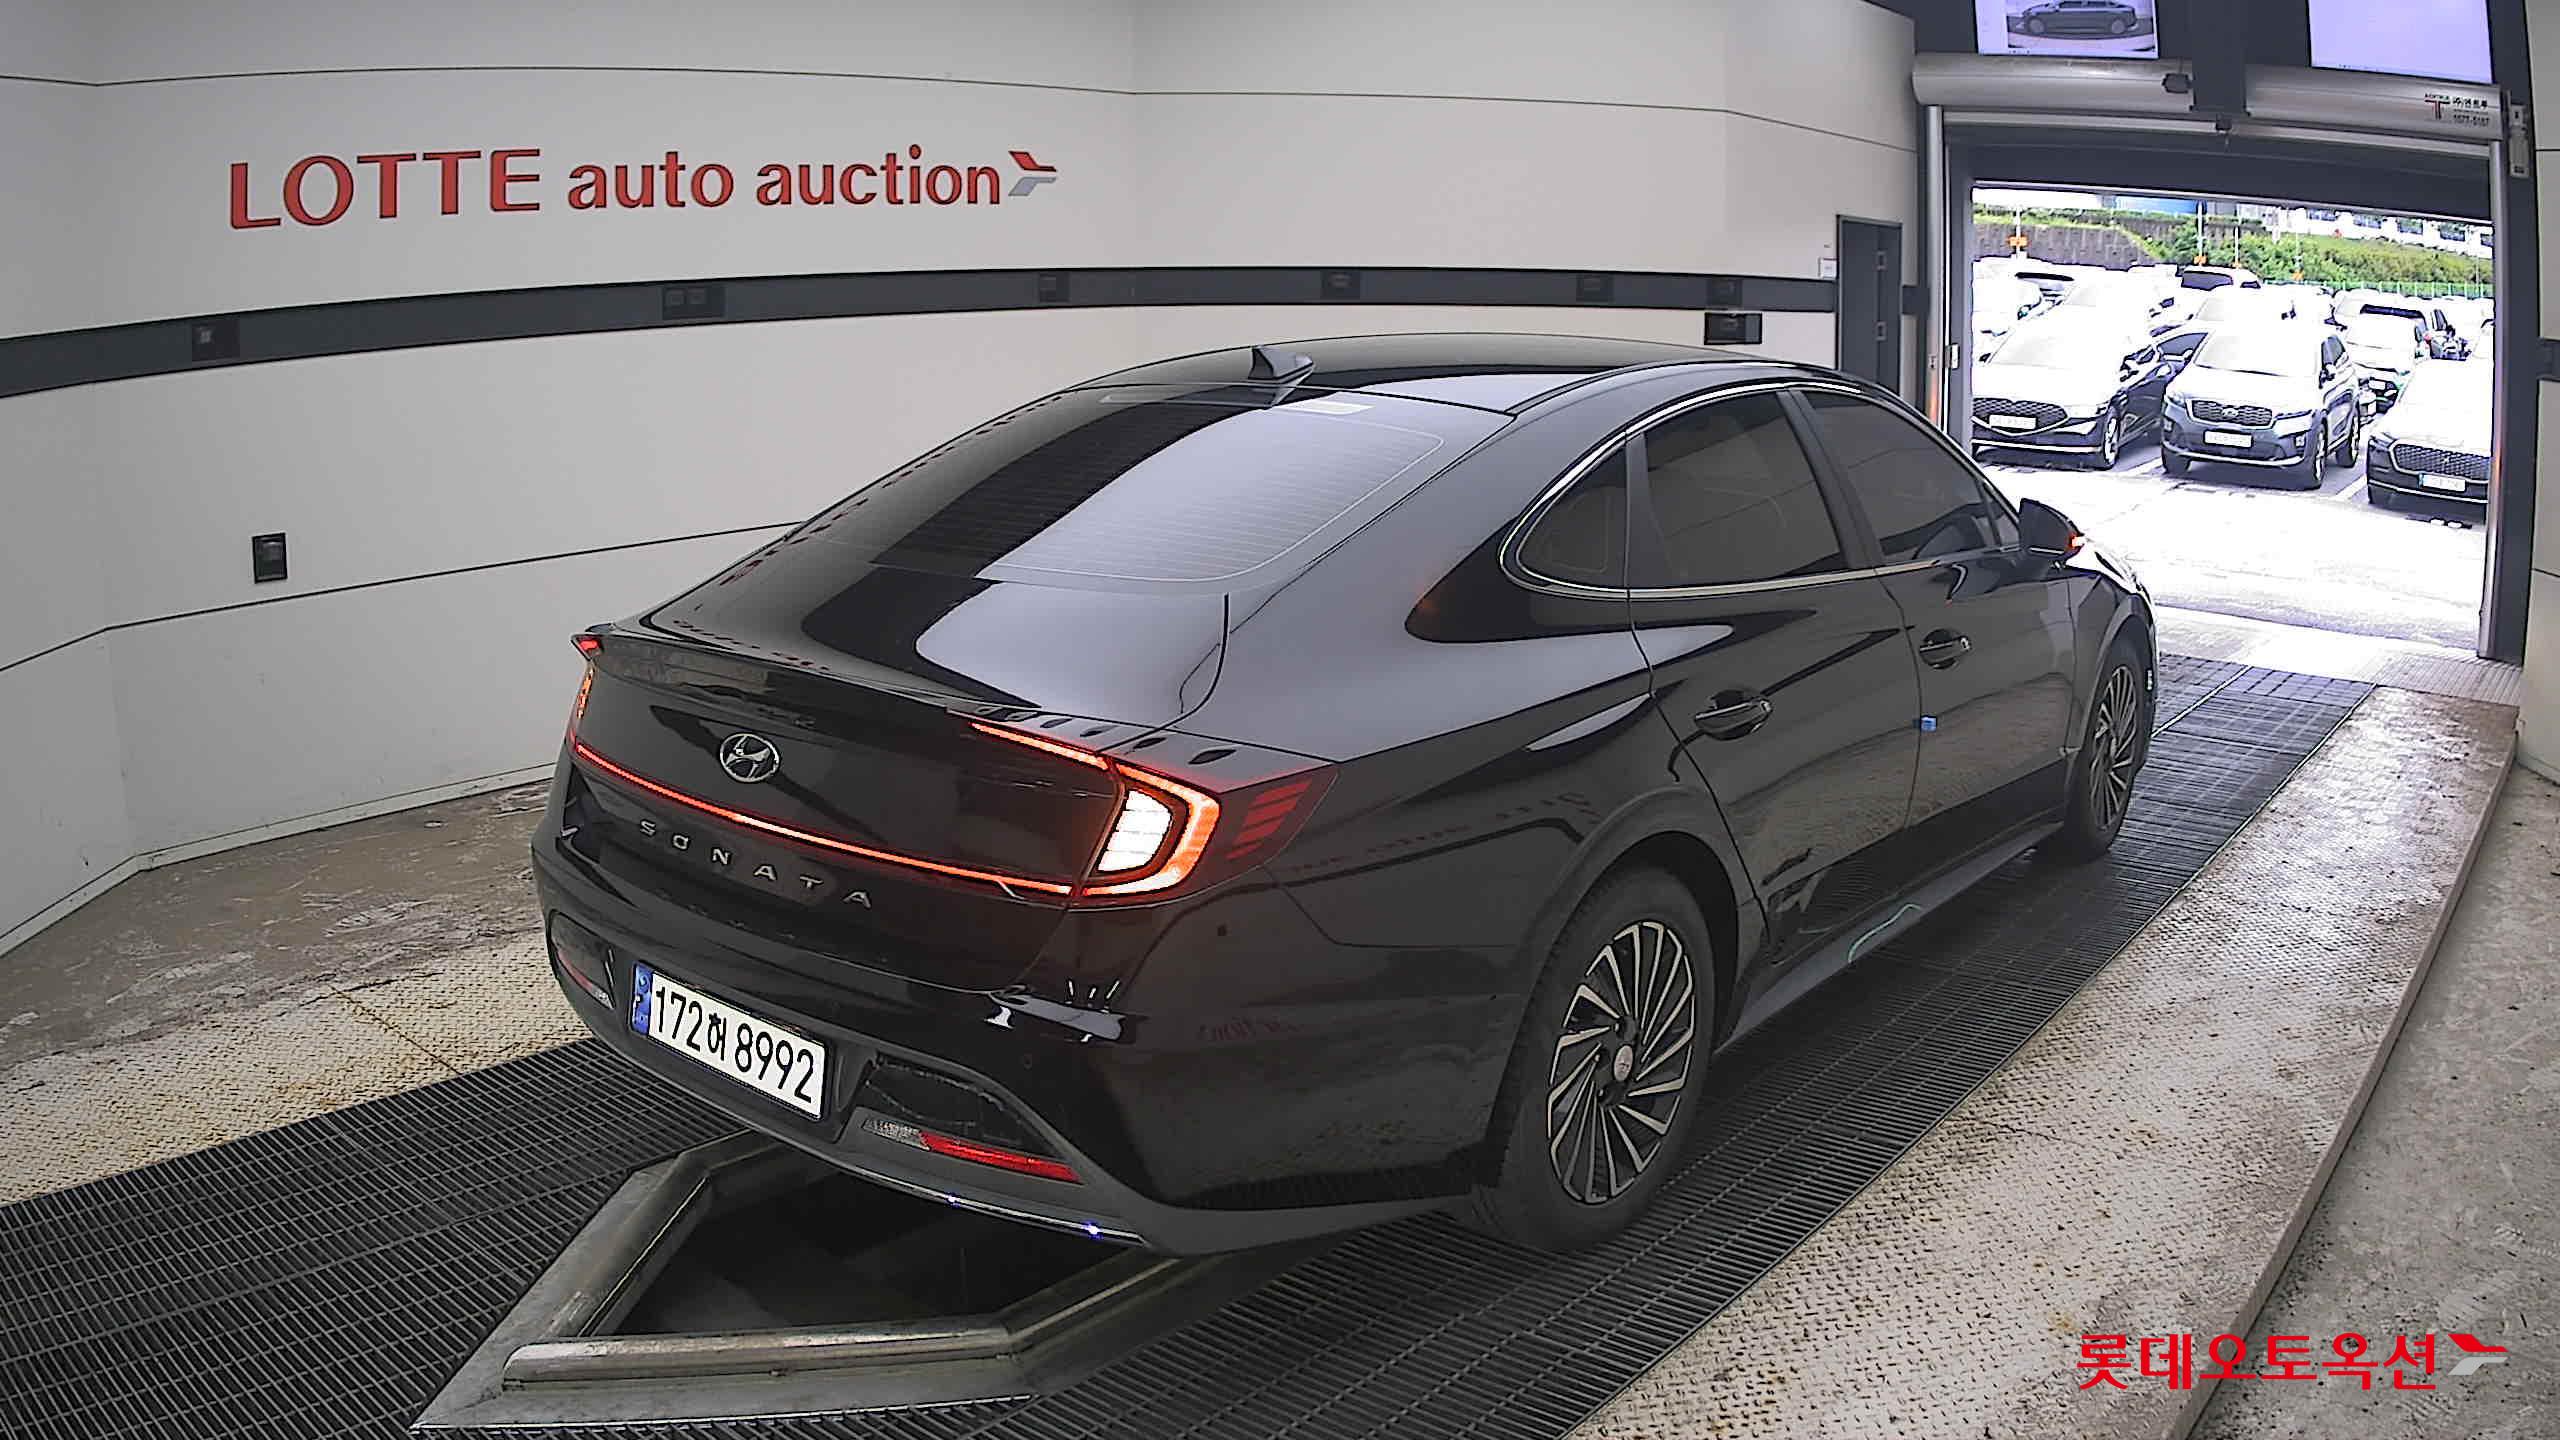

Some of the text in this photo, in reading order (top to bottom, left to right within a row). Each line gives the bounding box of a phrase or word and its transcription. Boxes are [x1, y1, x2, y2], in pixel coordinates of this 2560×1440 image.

[229, 144, 1001, 230] LOTTE auto auction
[639, 819, 872, 909] SONATA
